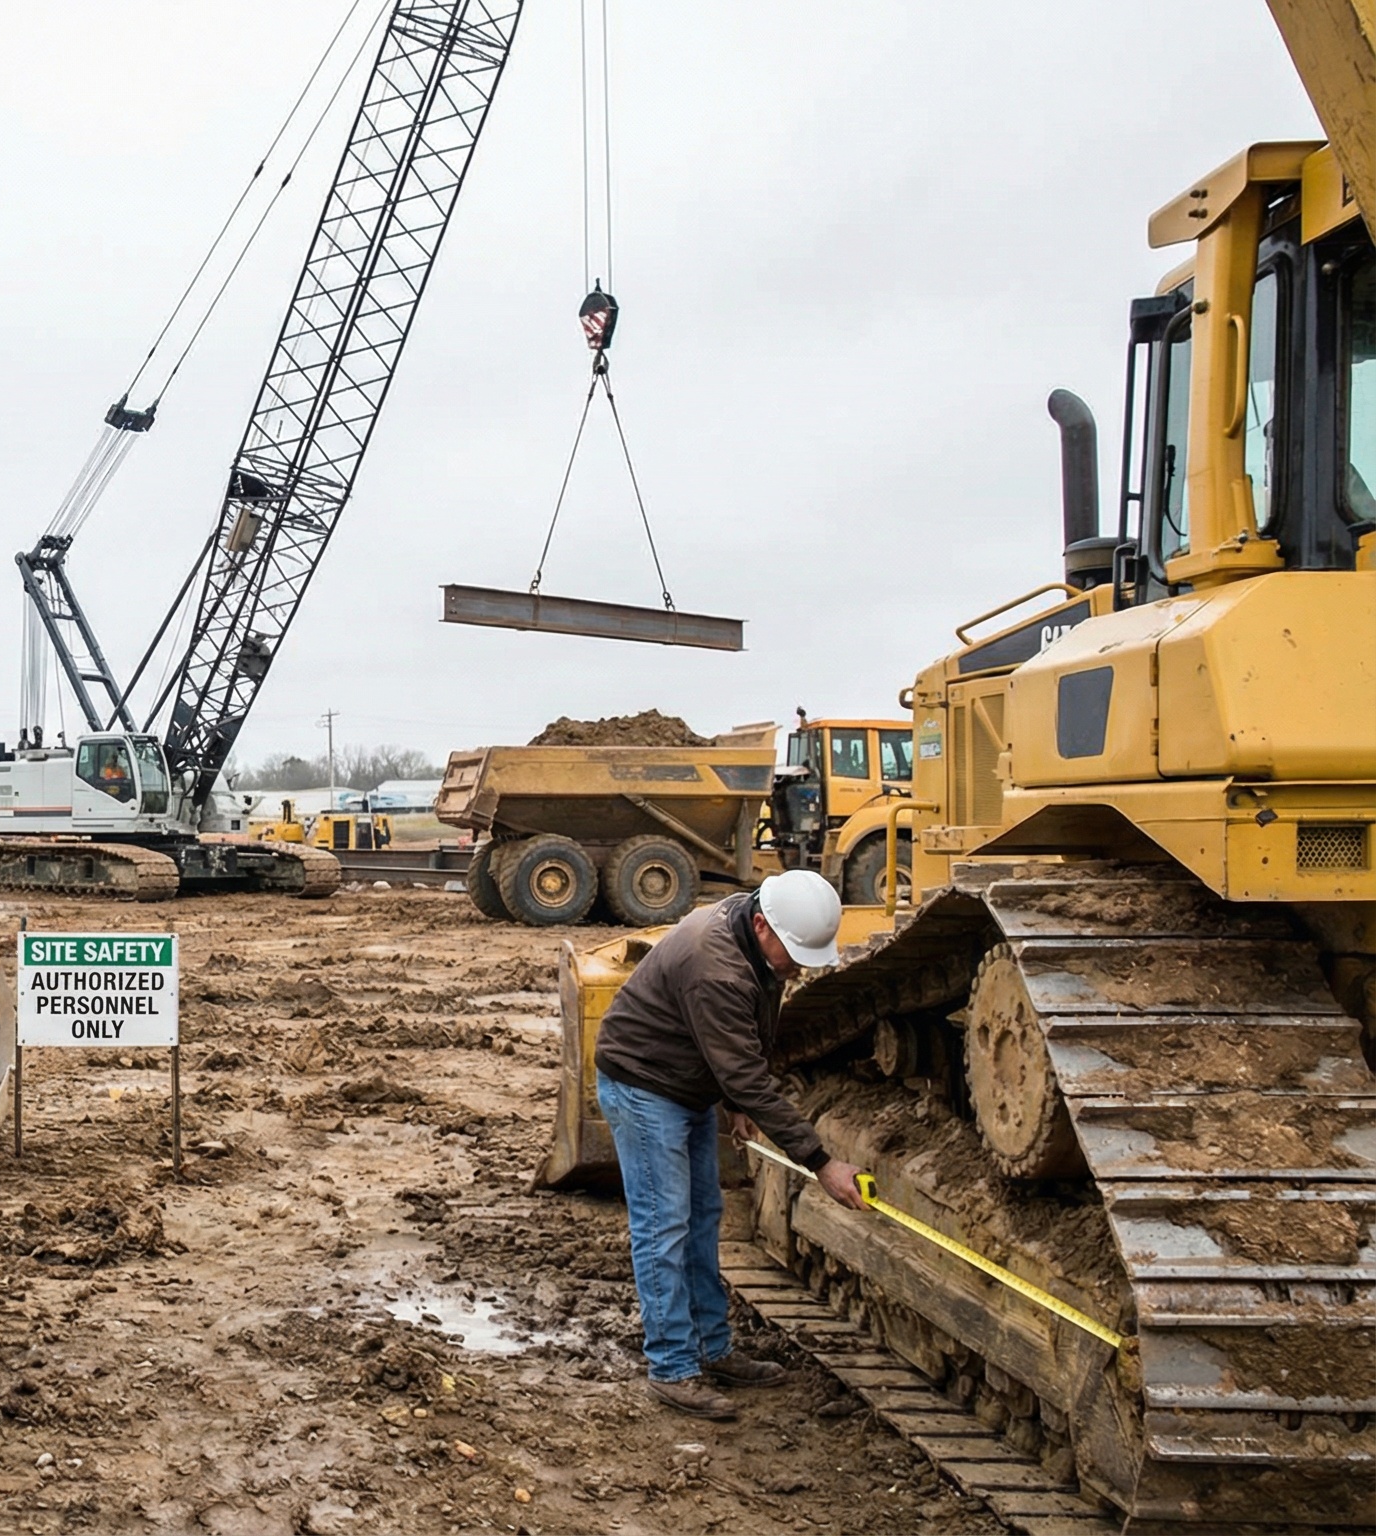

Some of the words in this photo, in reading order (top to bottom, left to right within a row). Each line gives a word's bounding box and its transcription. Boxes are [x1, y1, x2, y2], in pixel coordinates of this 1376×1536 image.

[31, 941, 78, 962] SITE
[83, 941, 165, 962] SAFETY
[30, 971, 165, 991] AUTHORIZED
[36, 995, 159, 1015] PERSONNEL
[71, 1019, 125, 1039] ONLY
